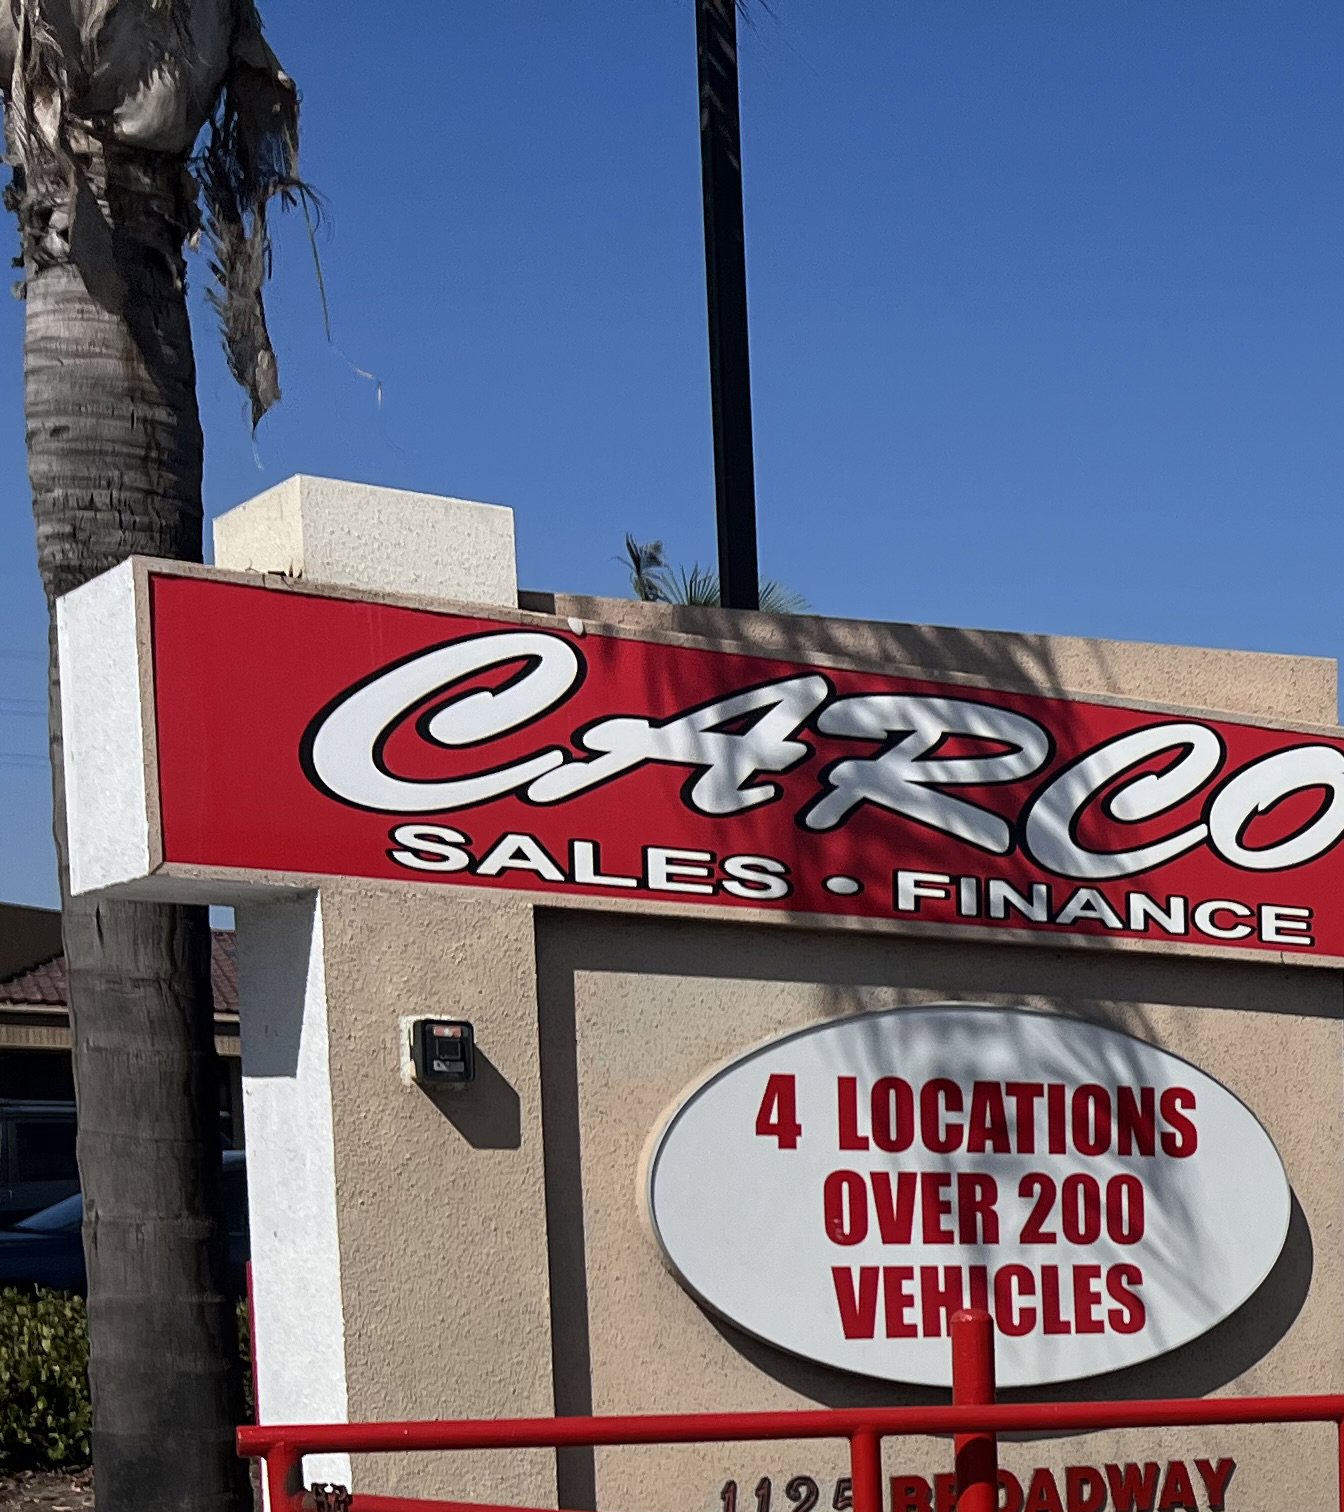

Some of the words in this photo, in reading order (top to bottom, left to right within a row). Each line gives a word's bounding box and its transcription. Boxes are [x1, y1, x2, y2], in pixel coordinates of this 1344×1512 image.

[389, 823, 791, 901] SALES
[895, 869, 1314, 946] FINANCE
[755, 1074, 801, 1150] 4
[837, 1075, 1198, 1158] LOCATIONS
[823, 1169, 1000, 1246] OVER
[1017, 1171, 1145, 1245] 200
[831, 1263, 1147, 1340] VEHICLES
